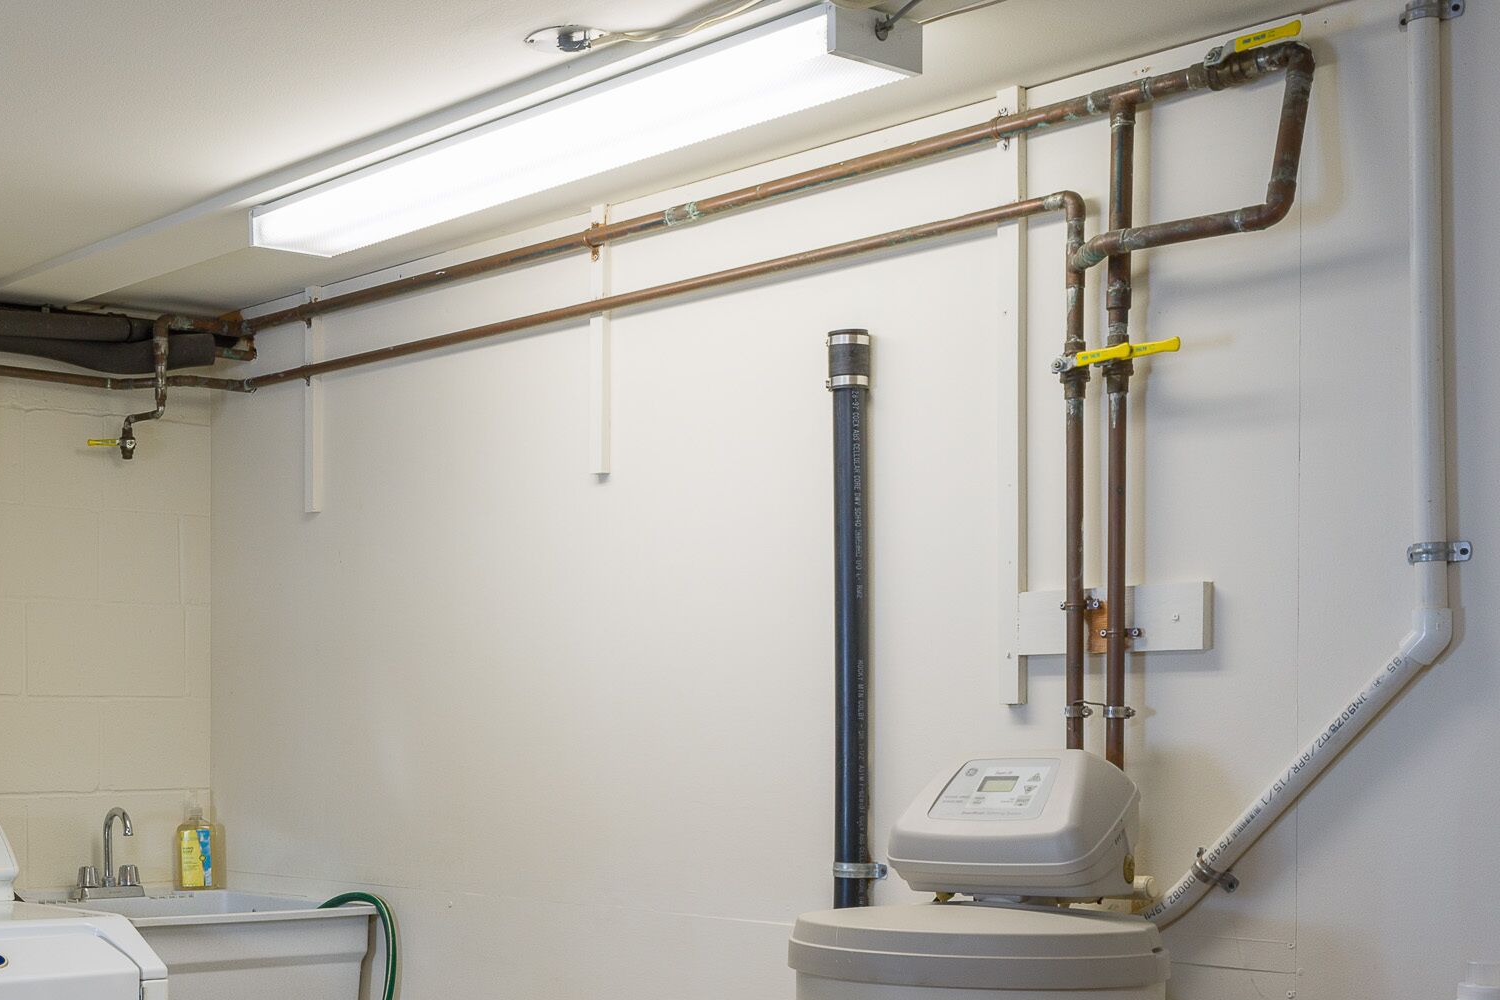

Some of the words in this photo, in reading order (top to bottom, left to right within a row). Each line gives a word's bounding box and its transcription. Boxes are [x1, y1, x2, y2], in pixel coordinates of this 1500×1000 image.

[851, 412, 861, 427] COEX
[852, 429, 861, 442] ABS
[852, 443, 861, 473] CELLULAR
[852, 475, 861, 490] CORE
[857, 700, 865, 721] COLBY
